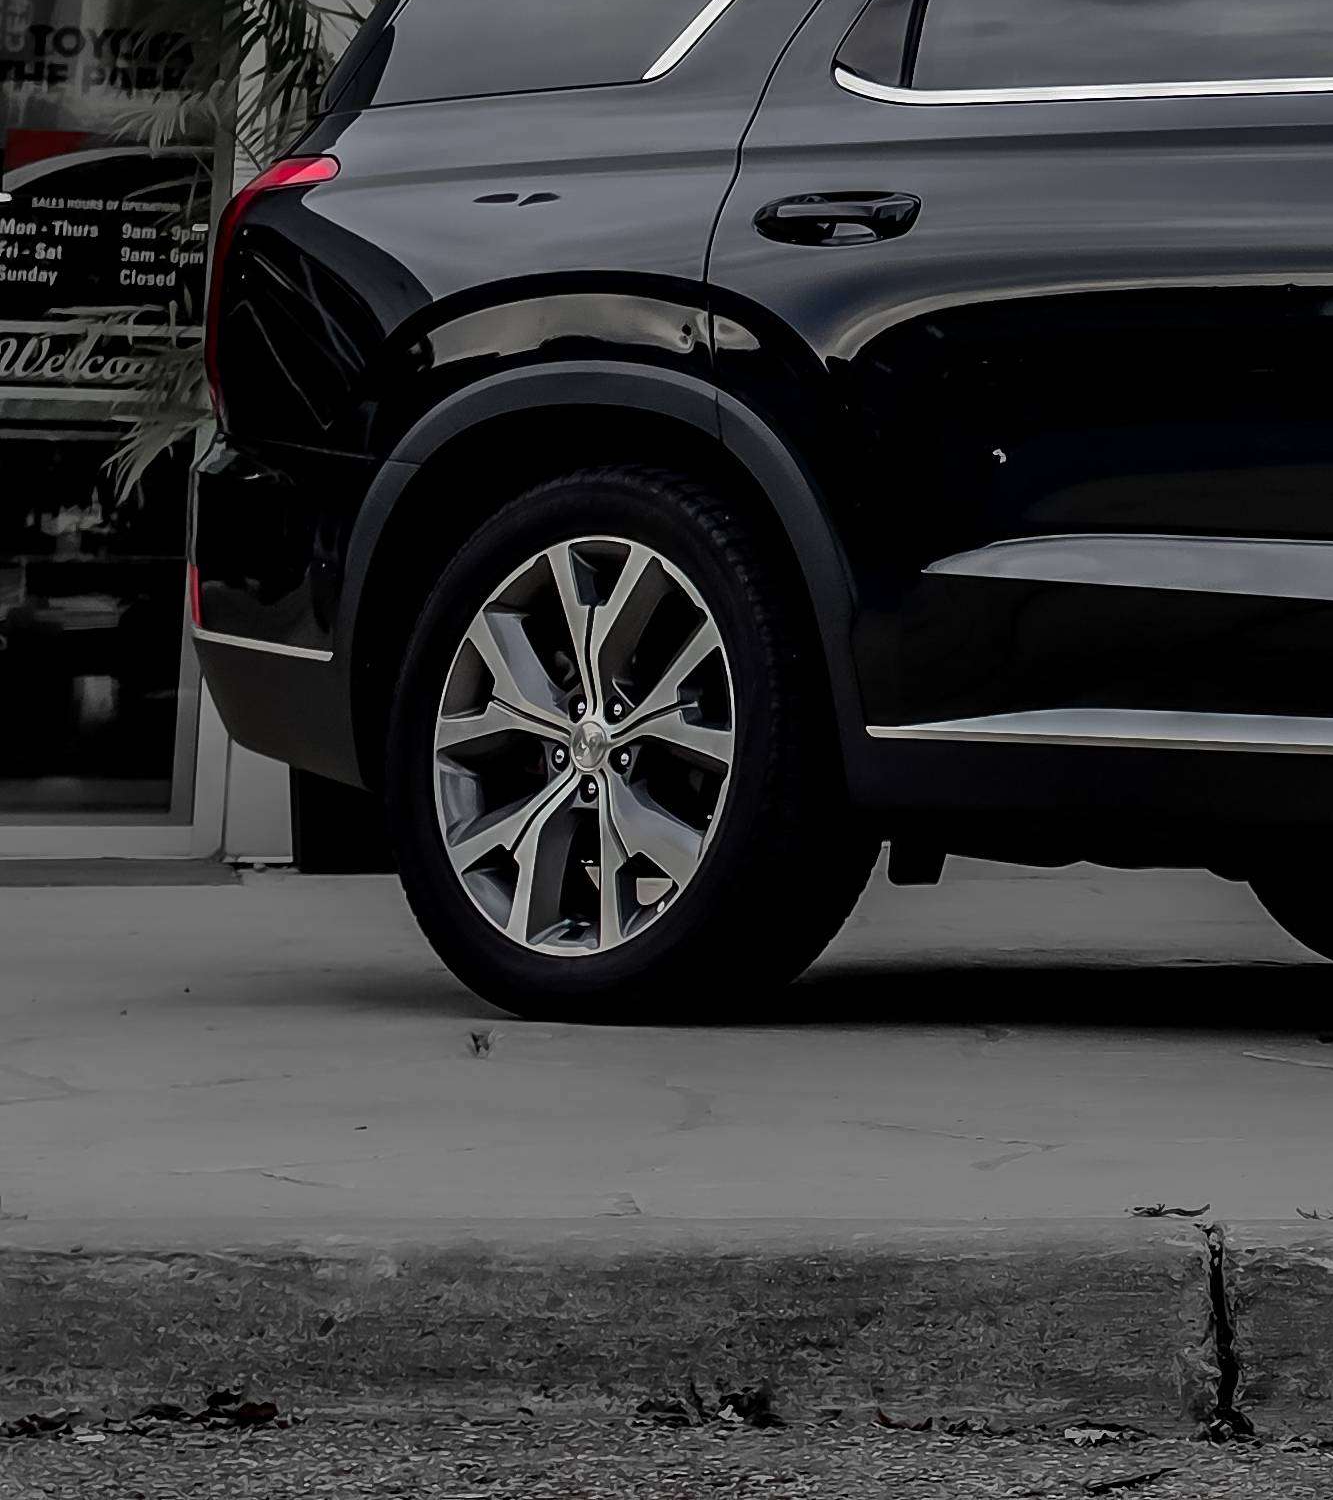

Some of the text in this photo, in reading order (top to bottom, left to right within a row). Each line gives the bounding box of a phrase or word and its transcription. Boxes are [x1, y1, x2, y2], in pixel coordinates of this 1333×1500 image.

[0, 218, 36, 236] Mon
[53, 220, 99, 237] Thurs
[121, 222, 157, 239] 9am
[35, 242, 63, 261] Sat
[120, 245, 155, 263] 9am
[170, 247, 204, 268] 6pm
[0, 265, 176, 287] Sunday Closed
